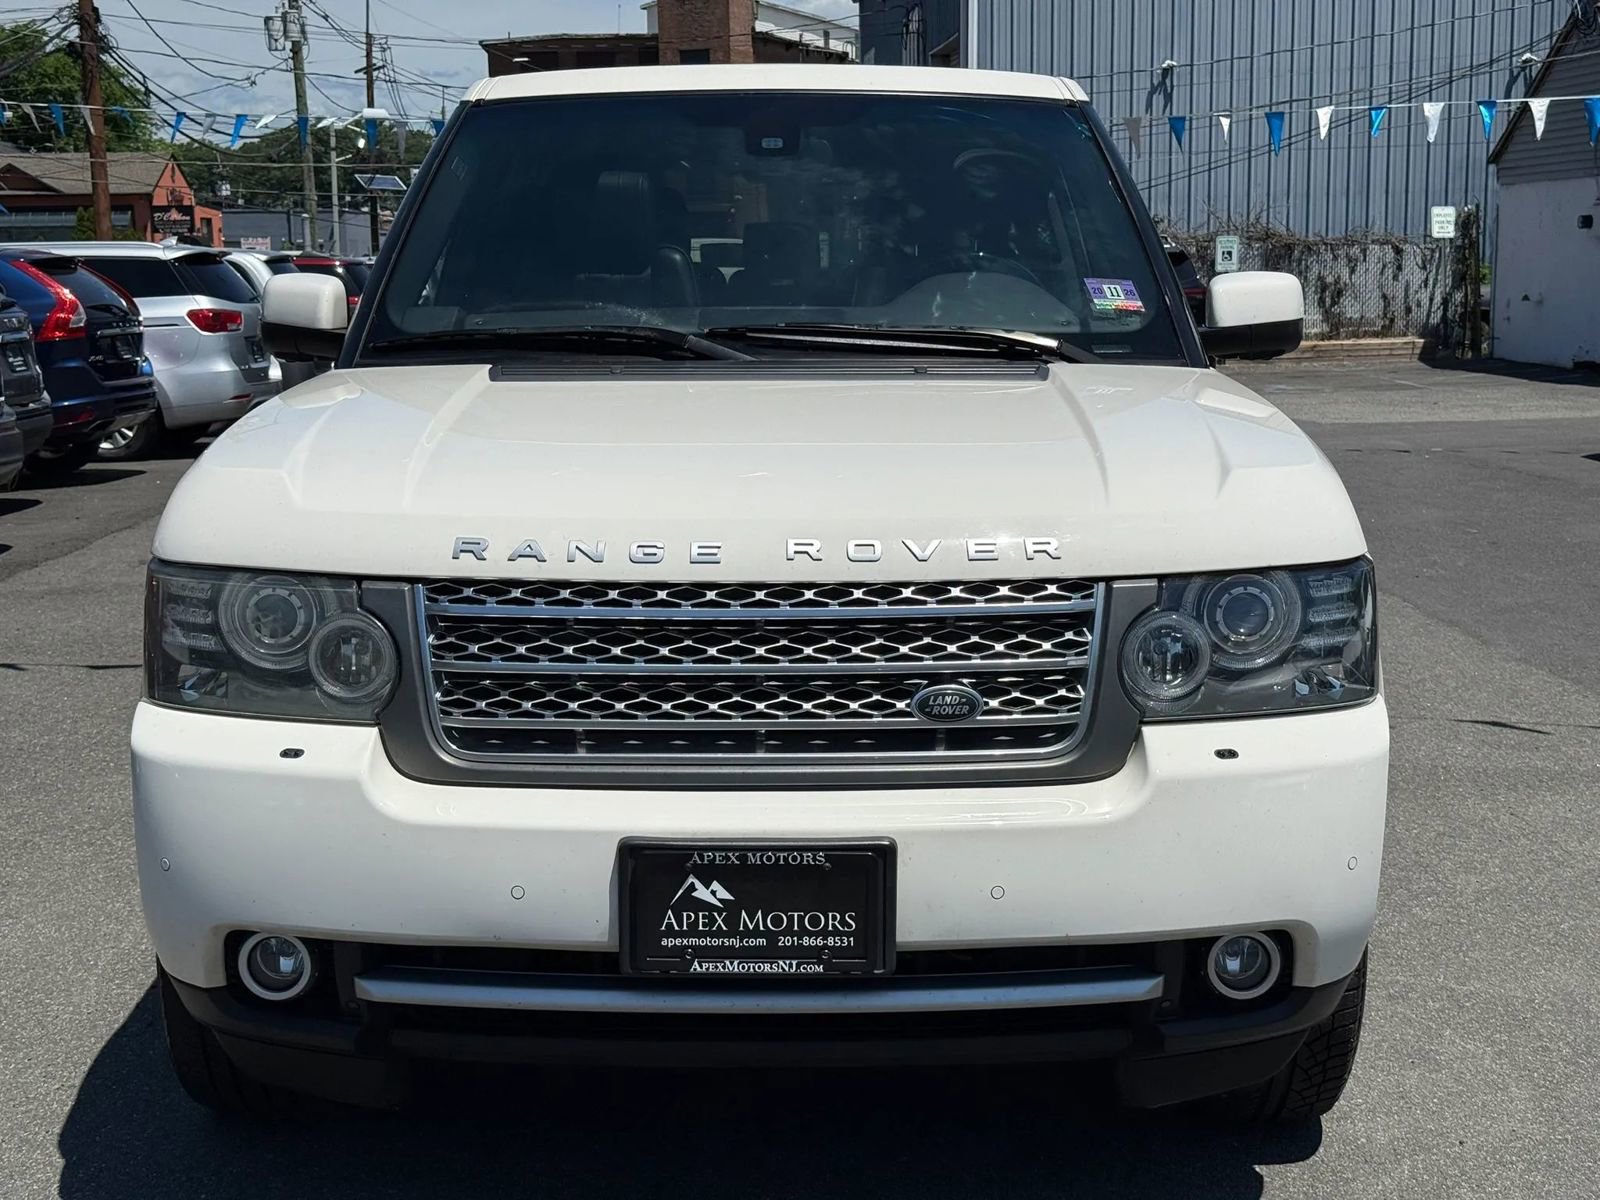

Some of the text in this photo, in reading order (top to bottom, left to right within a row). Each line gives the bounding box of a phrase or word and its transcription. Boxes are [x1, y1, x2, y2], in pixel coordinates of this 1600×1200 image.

[1091, 286, 1136, 298] 20 11 26
[451, 536, 1063, 565] RANGE ROVER
[928, 695, 961, 705] LAND
[931, 705, 970, 715] ROVER
[689, 851, 826, 865] APEX MOTORS
[659, 908, 857, 932] APEX MOTORS
[660, 936, 855, 949] apexmotorsnj.com 201-866-8531
